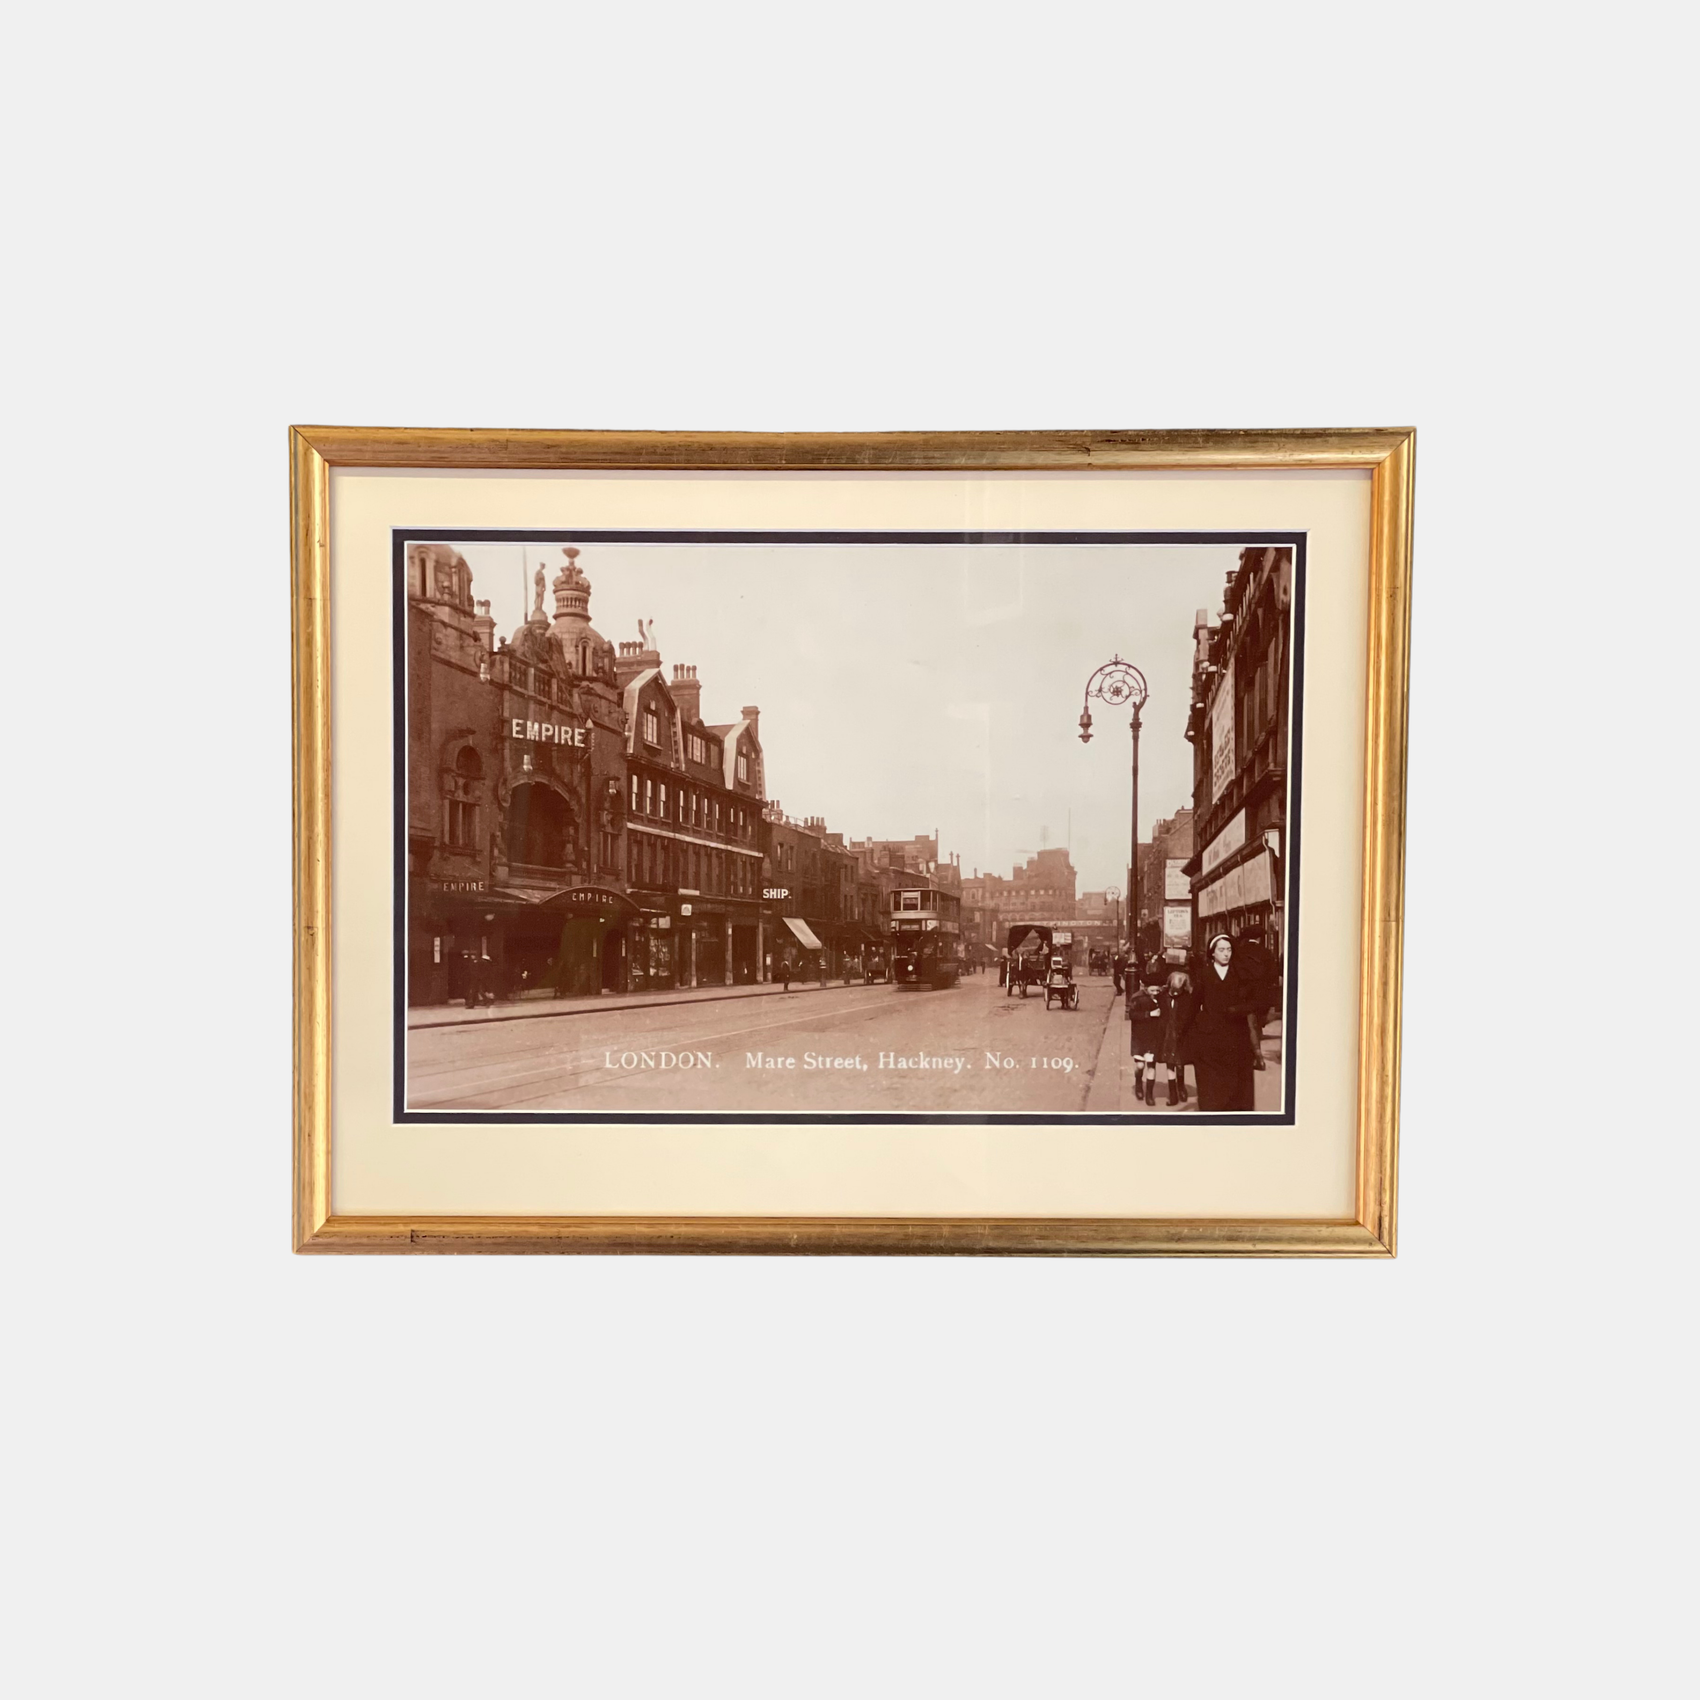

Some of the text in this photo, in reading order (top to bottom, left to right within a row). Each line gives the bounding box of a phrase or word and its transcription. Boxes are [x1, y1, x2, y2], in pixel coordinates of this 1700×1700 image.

[512, 718, 586, 748] EMPIRE
[443, 881, 485, 892] EMPIRE
[572, 892, 613, 904] EMPIRE
[604, 1050, 1079, 1074] LONDON. Mare Street, Hackney. No. 1109.
